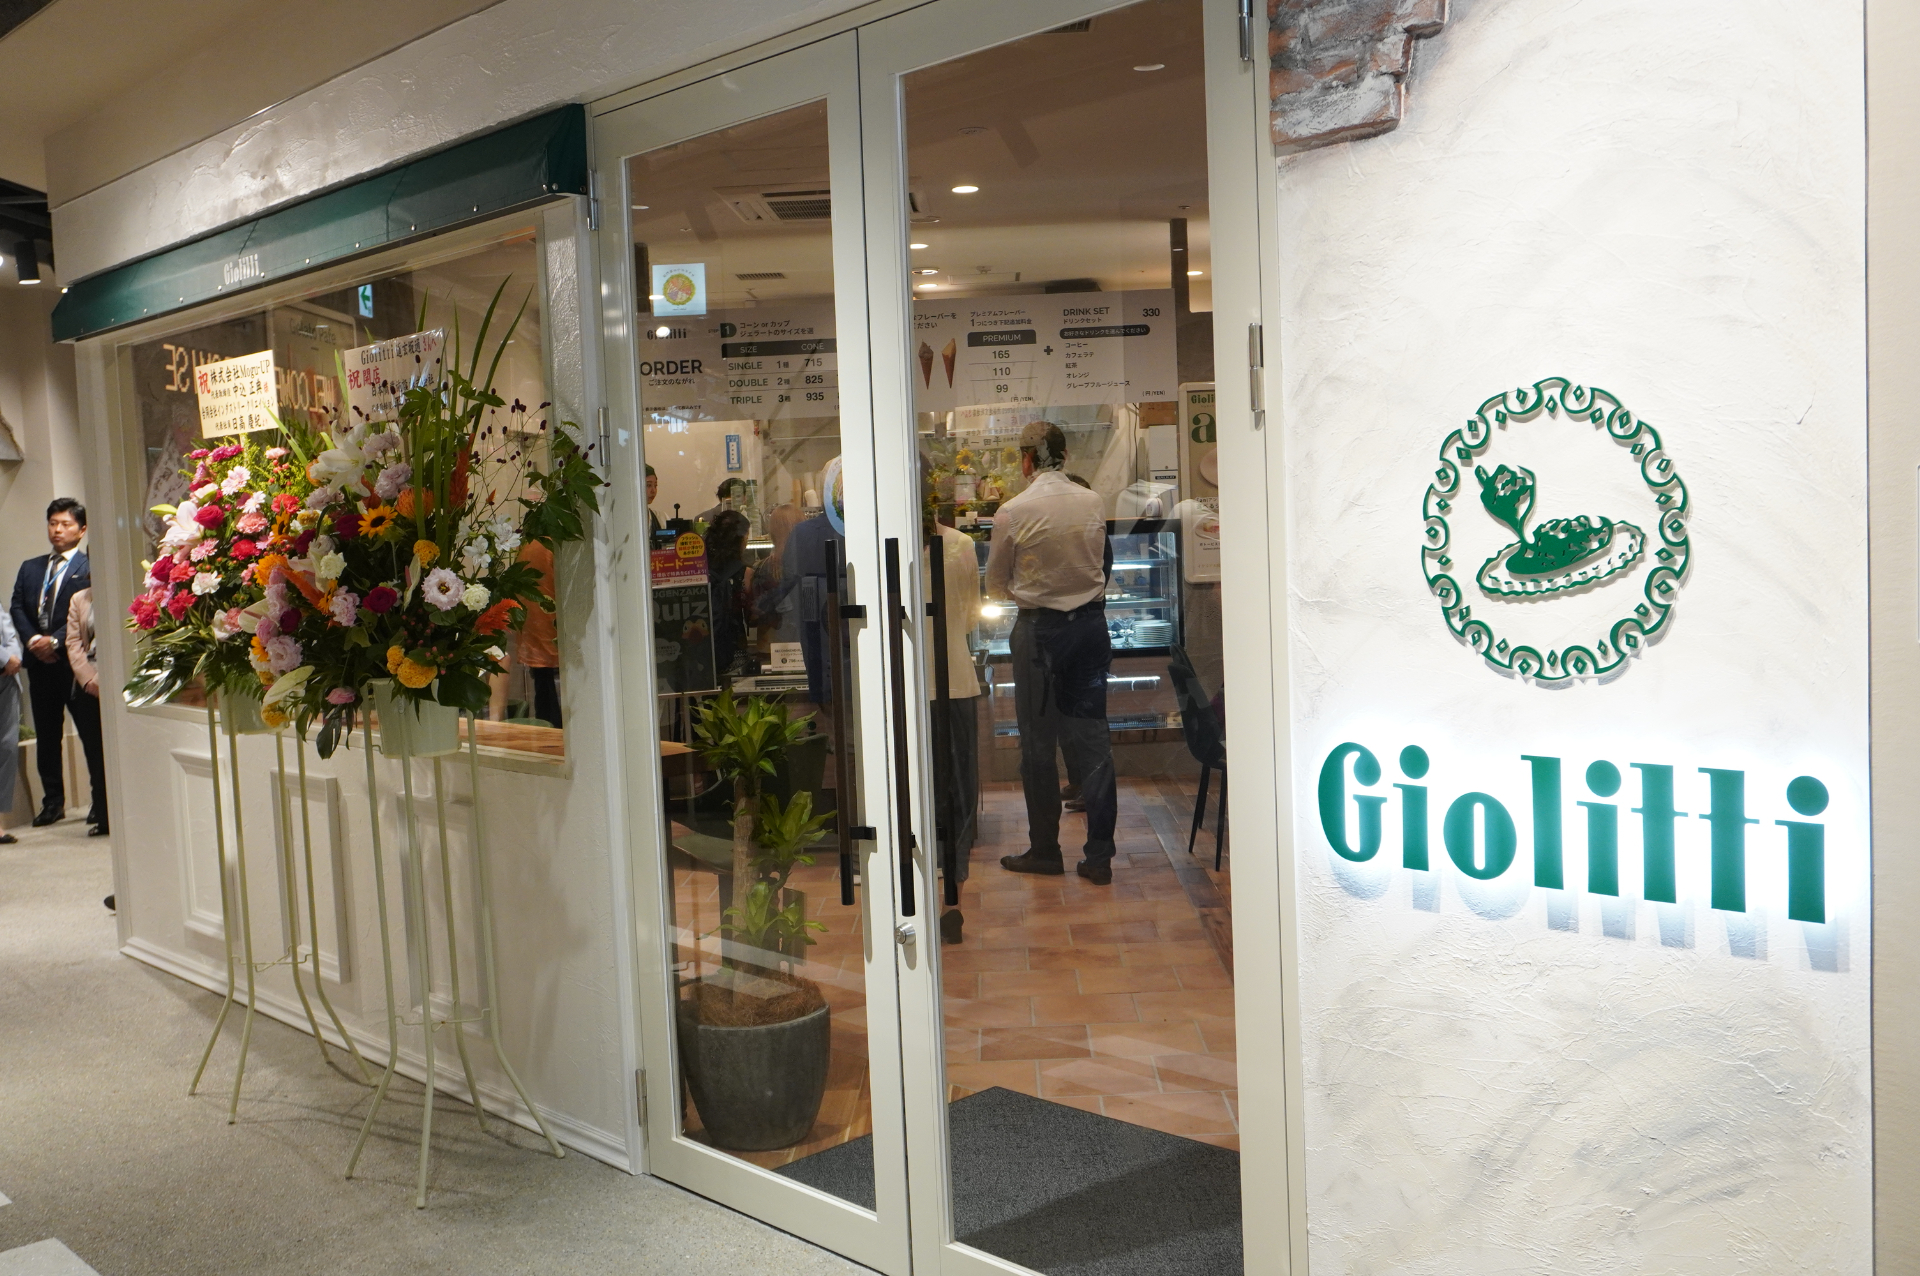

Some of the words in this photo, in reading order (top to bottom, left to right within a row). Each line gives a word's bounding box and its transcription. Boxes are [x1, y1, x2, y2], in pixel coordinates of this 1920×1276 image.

[223, 253, 260, 285] Giolitti
[970, 310, 1026, 318] プレミアムフレーバー
[1063, 308, 1092, 317] DRINK
[1093, 307, 1110, 315] SET
[1142, 308, 1160, 317] 330
[770, 320, 790, 328] カップ
[647, 328, 687, 340] Giitti
[725, 325, 730, 335] 1
[982, 334, 1021, 343] PREMIUM
[740, 346, 758, 354] SIZE
[801, 343, 825, 351] CONE
[992, 350, 1010, 359] 165
[640, 359, 703, 376] ORDER
[728, 361, 763, 371] SINGLE
[804, 358, 823, 367] 715
[993, 367, 1011, 376] 110
[198, 370, 211, 394] 祝
[648, 378, 695, 386] ご注文のながれ
[729, 378, 769, 388] DOUBLE
[805, 375, 824, 384] 825
[996, 384, 1009, 393] 99
[730, 396, 763, 405] TRIPLE
[806, 392, 825, 401] 935
[1191, 394, 1215, 404] Gioli
[1318, 742, 1829, 924] Giolitti
